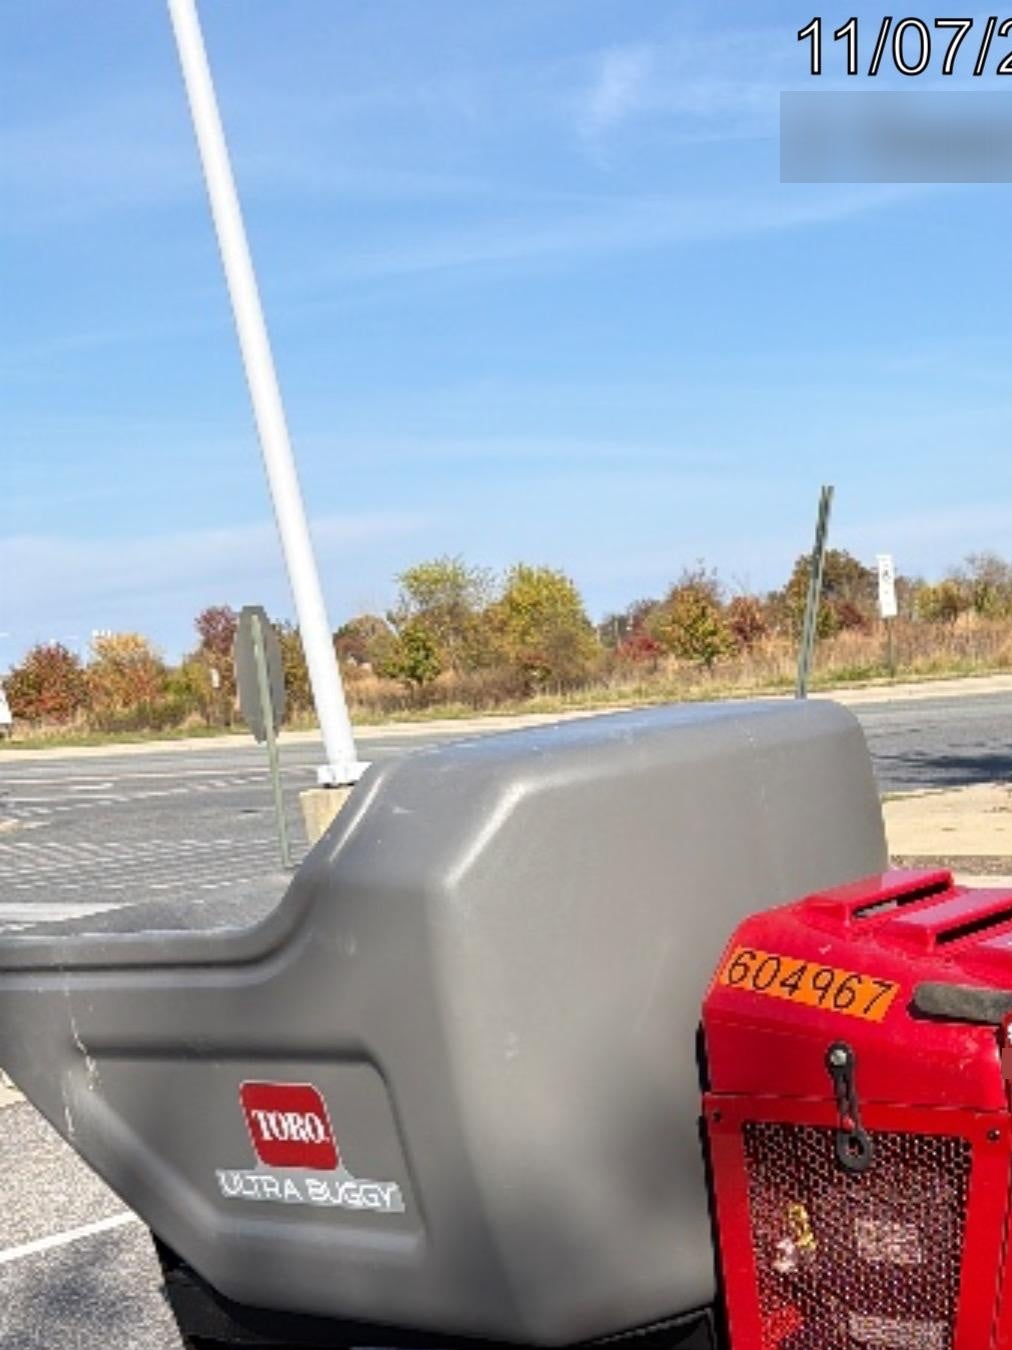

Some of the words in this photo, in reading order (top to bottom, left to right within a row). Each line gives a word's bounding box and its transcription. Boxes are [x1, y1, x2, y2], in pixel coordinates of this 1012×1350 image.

[728, 950, 894, 1015] 604967
[217, 1172, 302, 1200] ULTRA
[305, 1178, 393, 1207] BUGGY
